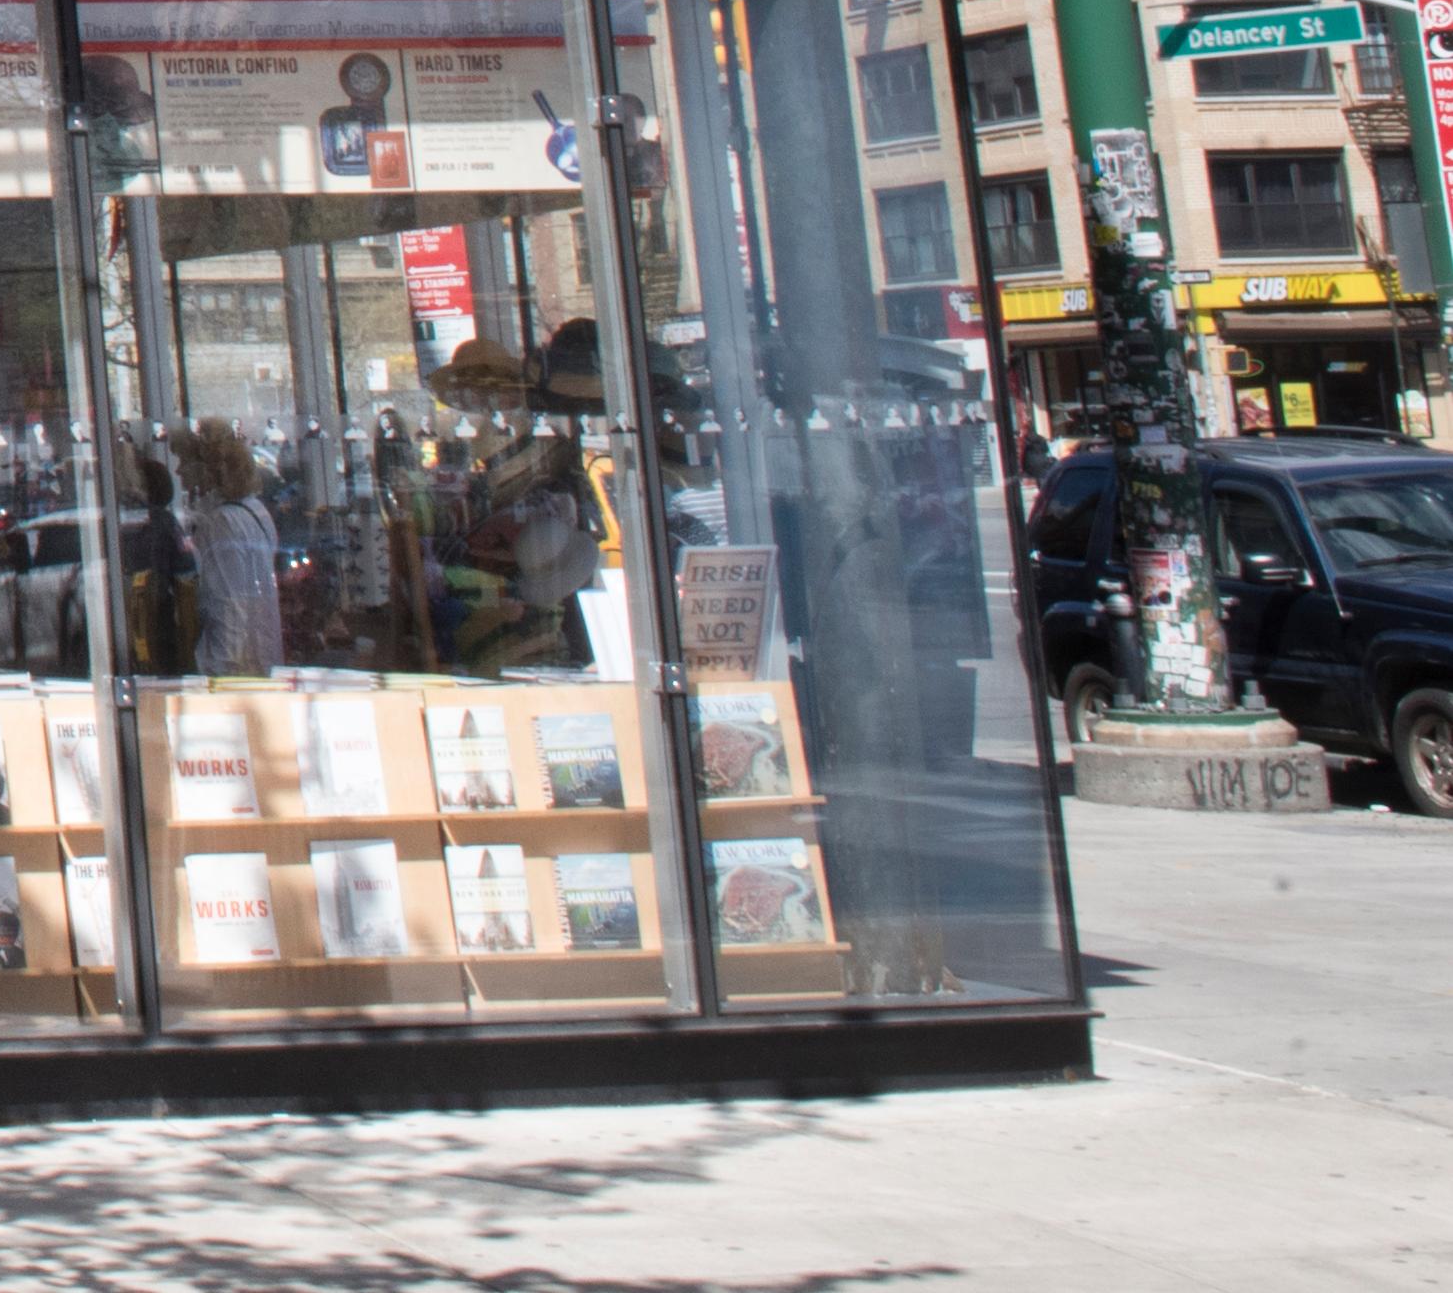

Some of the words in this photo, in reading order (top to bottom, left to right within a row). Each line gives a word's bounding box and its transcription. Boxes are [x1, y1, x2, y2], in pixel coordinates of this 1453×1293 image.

[83, 21, 109, 39] The
[112, 21, 161, 39] Lower
[206, 19, 238, 38] Side
[246, 19, 324, 38] Tenement
[328, 19, 397, 38] Museum
[418, 18, 441, 42] by
[1188, 23, 1287, 50] Delancey
[1300, 17, 1326, 39] St
[162, 57, 231, 75] VICTORIA
[235, 56, 299, 74] CONFINO
[414, 54, 455, 72] HARD
[458, 54, 503, 72] TIMES
[1240, 275, 1338, 301] SUBWAY
[1060, 289, 1087, 311] SUB
[691, 564, 764, 582] IRISH
[691, 597, 757, 615] NEED
[696, 621, 746, 643] NOT
[56, 723, 75, 738] THE
[547, 748, 616, 763] MANNAHATTA
[177, 758, 249, 778] WORKS
[566, 889, 633, 904] MANNAHATTA
[196, 900, 268, 919] WORKS
